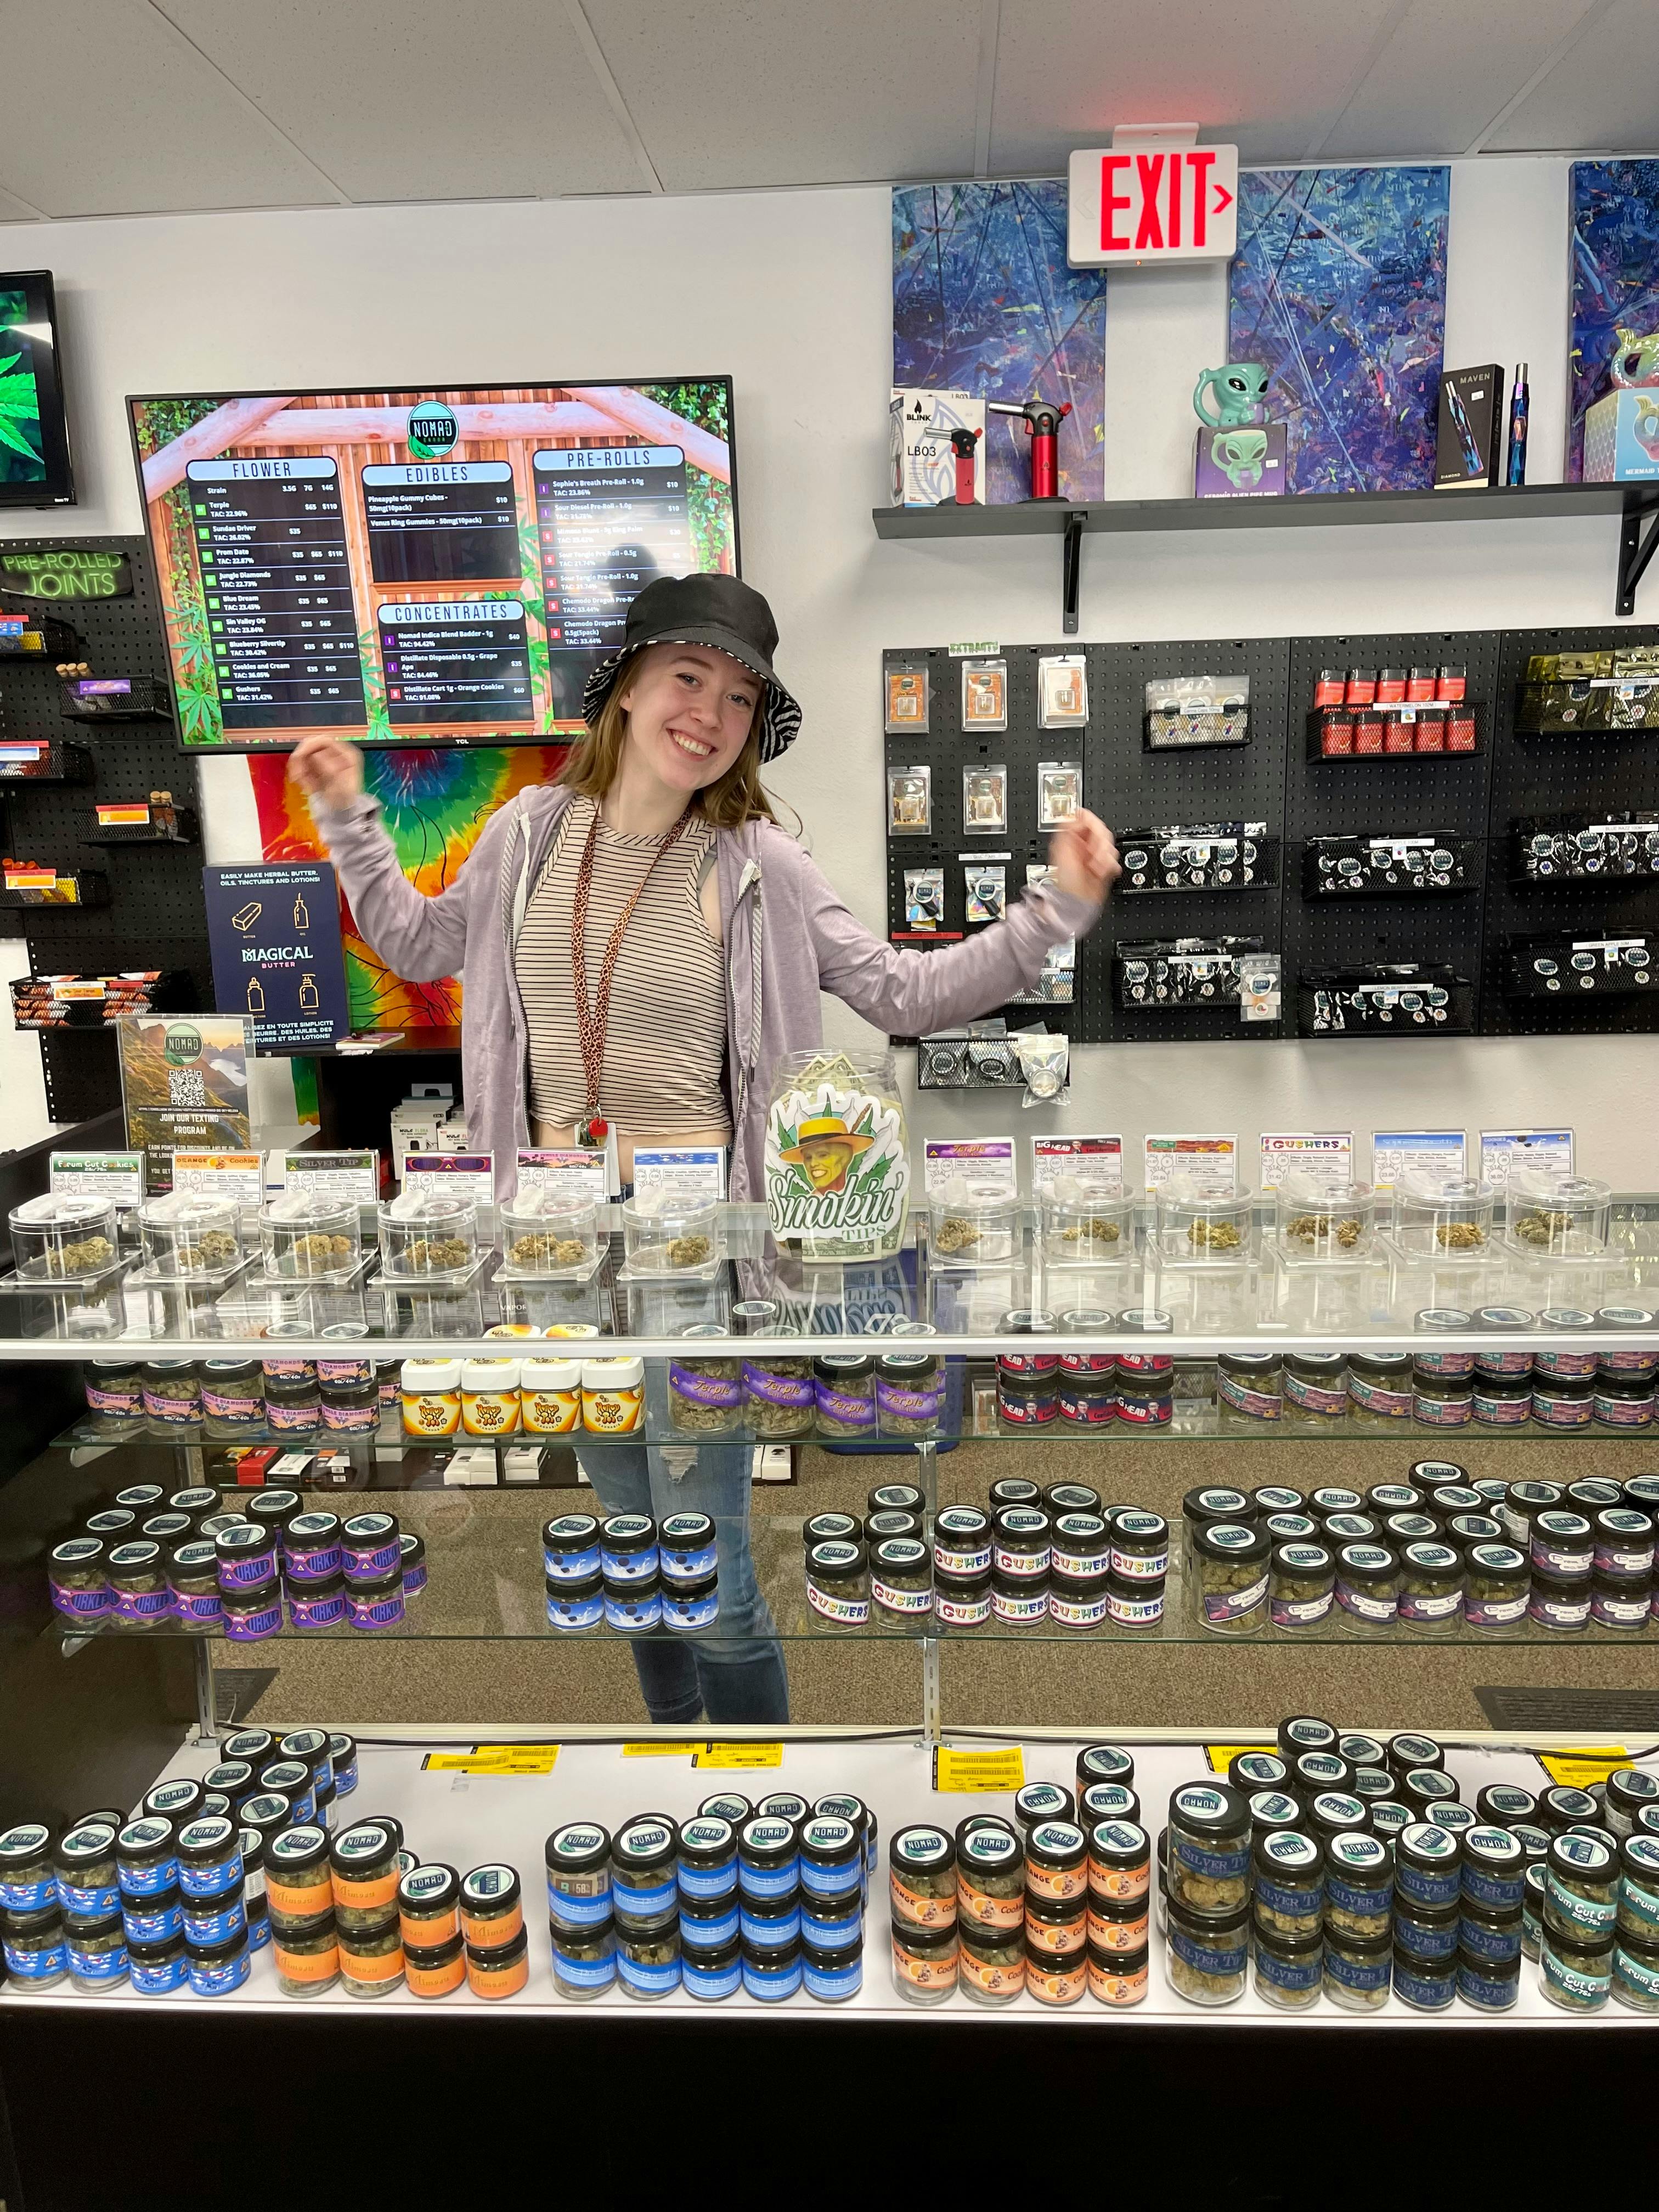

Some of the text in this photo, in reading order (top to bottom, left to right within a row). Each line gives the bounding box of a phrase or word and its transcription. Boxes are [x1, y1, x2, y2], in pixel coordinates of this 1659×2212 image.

[1101, 152, 1216, 250] EXIT
[1460, 373, 1491, 384] MAVEN
[414, 421, 452, 438] NOMAD
[568, 450, 650, 467] PRE-ROLLS
[908, 446, 936, 456] LB03
[233, 462, 291, 478] FLOWER
[407, 466, 467, 482] EDIBLES
[3, 554, 122, 571] PRE-ROLLED
[25, 573, 115, 596] JOINTS
[396, 604, 507, 621] CONCENTRATES
[241, 946, 313, 962] MAGICAL
[169, 1038, 199, 1051] NOMAD
[160, 1113, 219, 1123] JOIN OUR TEXTING
[173, 1126, 206, 1135] PROGRAM
[953, 1144, 986, 1153] Terple
[1051, 1144, 1071, 1152] HEAD
[1273, 1140, 1339, 1149] GUSHERS
[842, 1224, 887, 1241] TIPS
[693, 1380, 730, 1395] Terple
[764, 1379, 801, 1395] Terple
[829, 1397, 866, 1413] Terple
[886, 1391, 923, 1408] Terple
[534, 1402, 559, 1415] Honey
[1125, 1403, 1147, 1417] HEAD
[1290, 1550, 1320, 1559] NOMAD
[809, 1588, 868, 1617] GUSHERS
[159, 1787, 190, 1802] NOMAD
[191, 1826, 225, 1836] NOMAD
[755, 1827, 786, 1837] NOMAD
[815, 1827, 844, 1837] NOMAD
[347, 1834, 379, 1846] NOMAD
[907, 1838, 939, 1848] NOMAD
[977, 1837, 1007, 1848] NOMAD
[1344, 1843, 1375, 1854] NOMAD
[1181, 1845, 1227, 1870] SILVER
[412, 1875, 443, 1888] NOMAD
[1329, 1884, 1374, 1908] SILVER
[1576, 1904, 1596, 1920] Cut
[1175, 1936, 1219, 1967] SILVER
